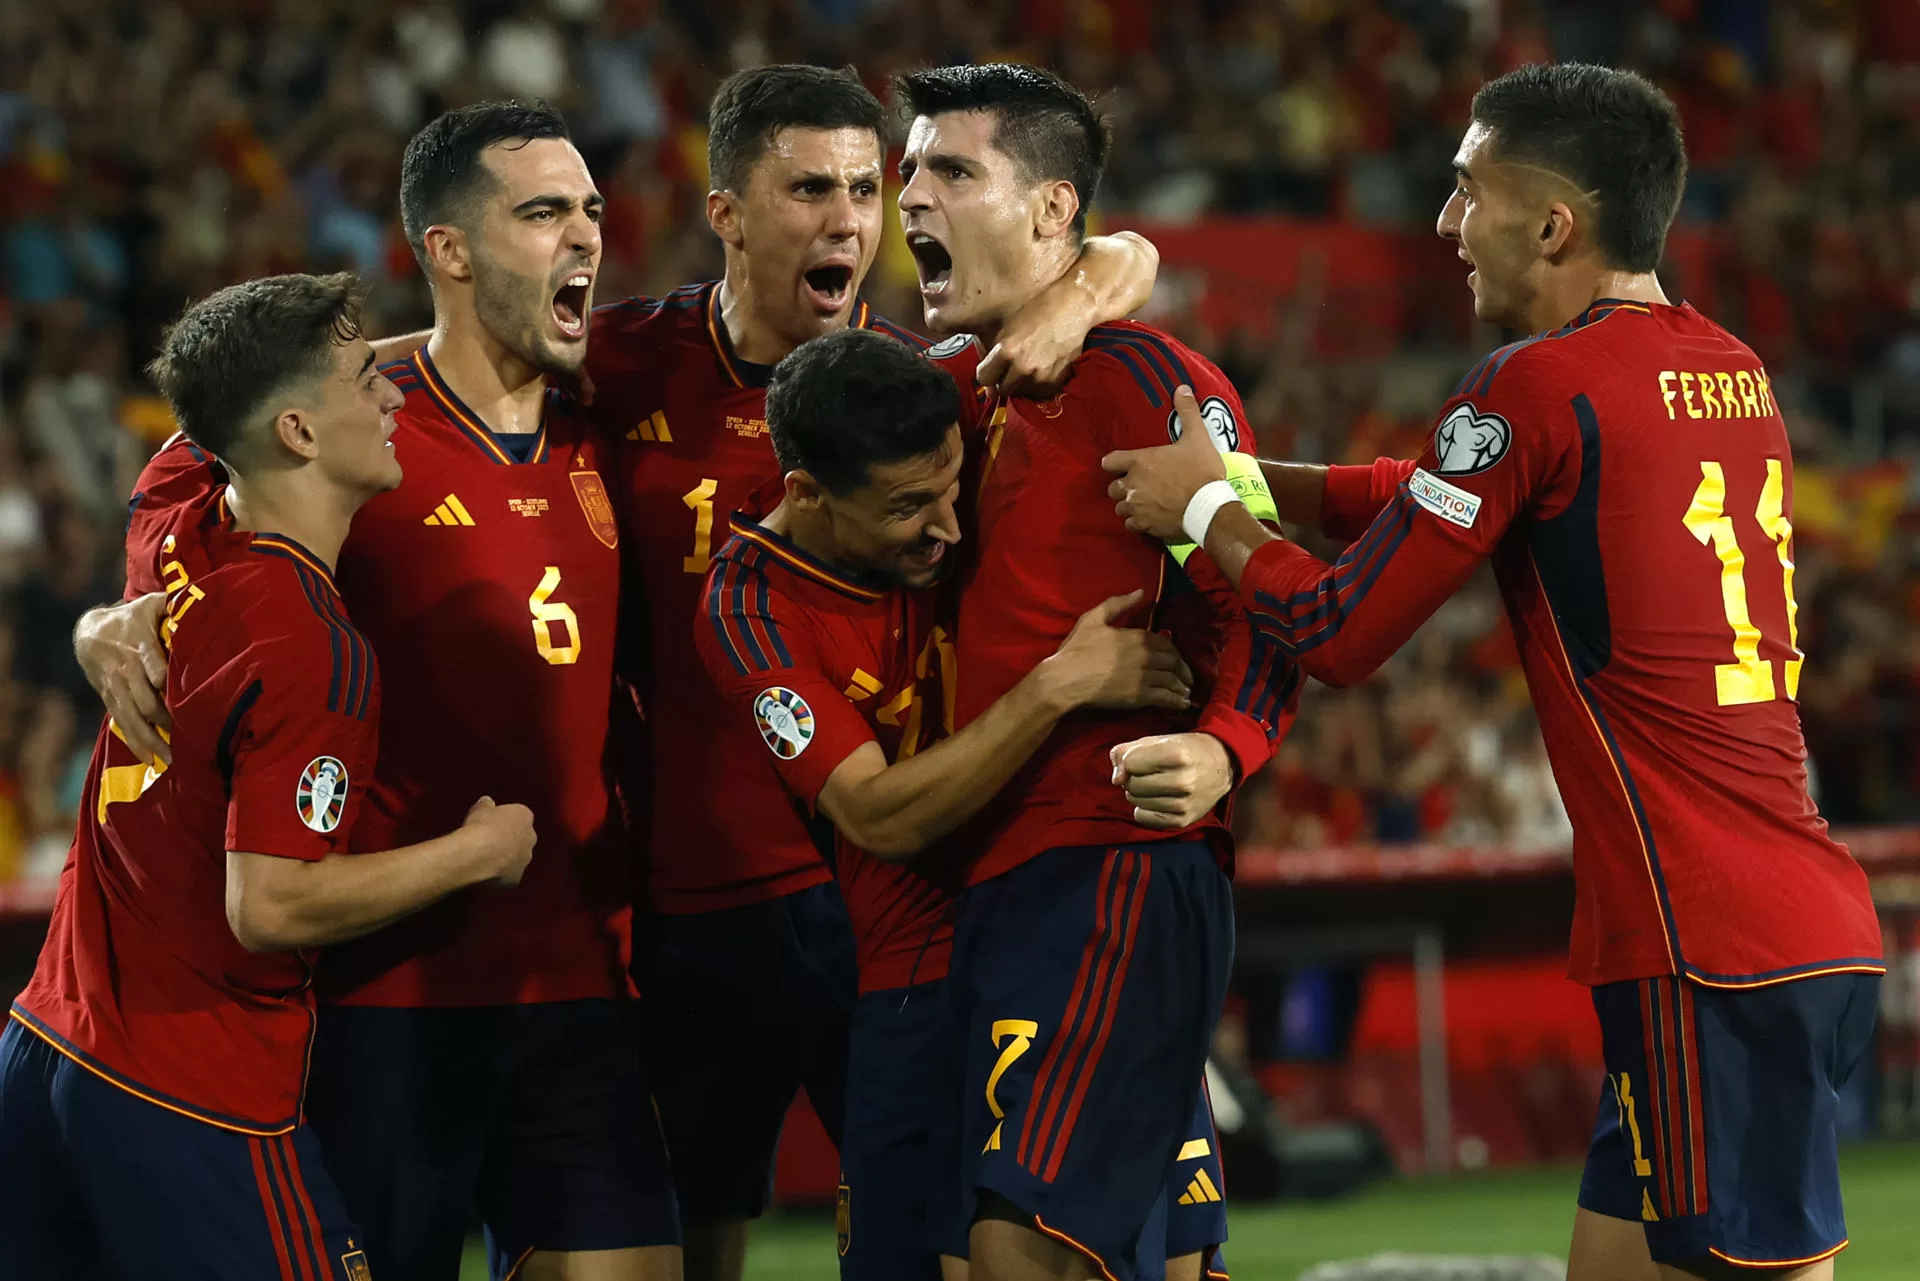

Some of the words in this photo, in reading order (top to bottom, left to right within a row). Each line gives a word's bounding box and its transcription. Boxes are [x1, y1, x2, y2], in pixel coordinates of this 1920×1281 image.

[1658, 366, 1774, 420] FERRAN
[1410, 477, 1476, 518] FOUNDATION
[529, 566, 582, 665] 6
[1681, 459, 1805, 707] 11
[982, 1019, 1039, 1156] 7
